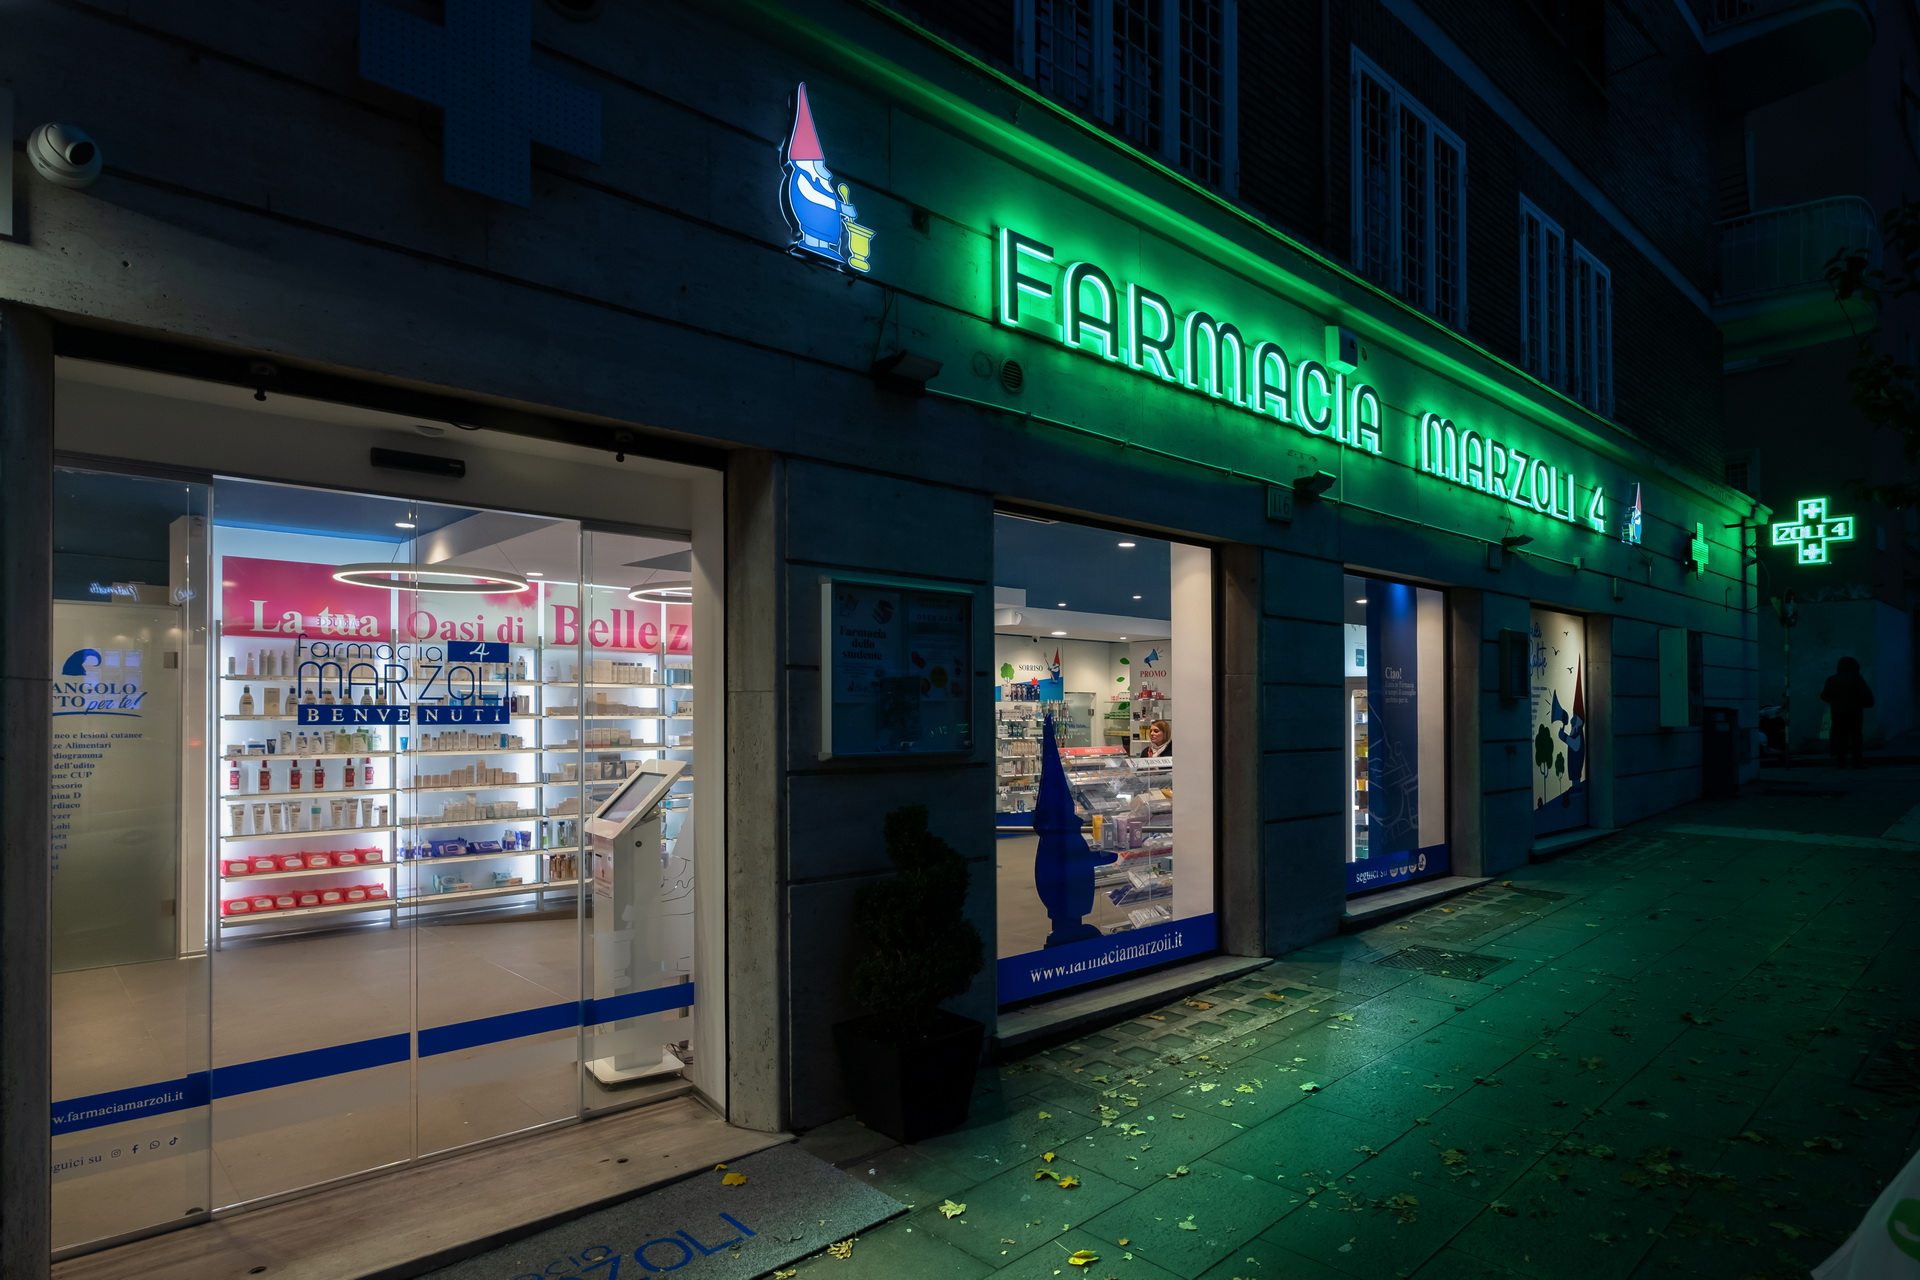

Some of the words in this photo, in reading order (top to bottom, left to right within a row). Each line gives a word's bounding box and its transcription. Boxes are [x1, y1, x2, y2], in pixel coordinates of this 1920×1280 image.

[1001, 227, 1383, 455] FARMACIA
[1421, 412, 1576, 523] MARZOLI
[1588, 487, 1607, 533] 4
[1273, 493, 1290, 515] 116
[1830, 522, 1847, 537] 4
[250, 599, 306, 634] La
[318, 606, 381, 637] tua
[406, 610, 486, 643] Oasi
[497, 616, 526, 644] di
[839, 625, 888, 640] Farmacia
[297, 633, 443, 662] farmacia
[469, 643, 491, 662] 4
[851, 638, 876, 650] dello
[842, 650, 883, 661] studente
[1018, 664, 1044, 672] SORRISO
[1139, 670, 1167, 678] PROMO
[1384, 666, 1402, 680] Ciao!
[297, 661, 510, 701] MARZOLI
[52, 682, 137, 695] ANGOLO
[52, 695, 86, 708] TO
[84, 699, 115, 716] per
[118, 691, 148, 710] te!
[306, 708, 502, 723] BENVENUTI
[65, 741, 112, 749] Alimentari
[70, 771, 93, 779] CUP
[73, 791, 82, 799] D
[51, 1091, 184, 1125] w.farmaciamarzoli.it
[88, 1155, 102, 1164] su
